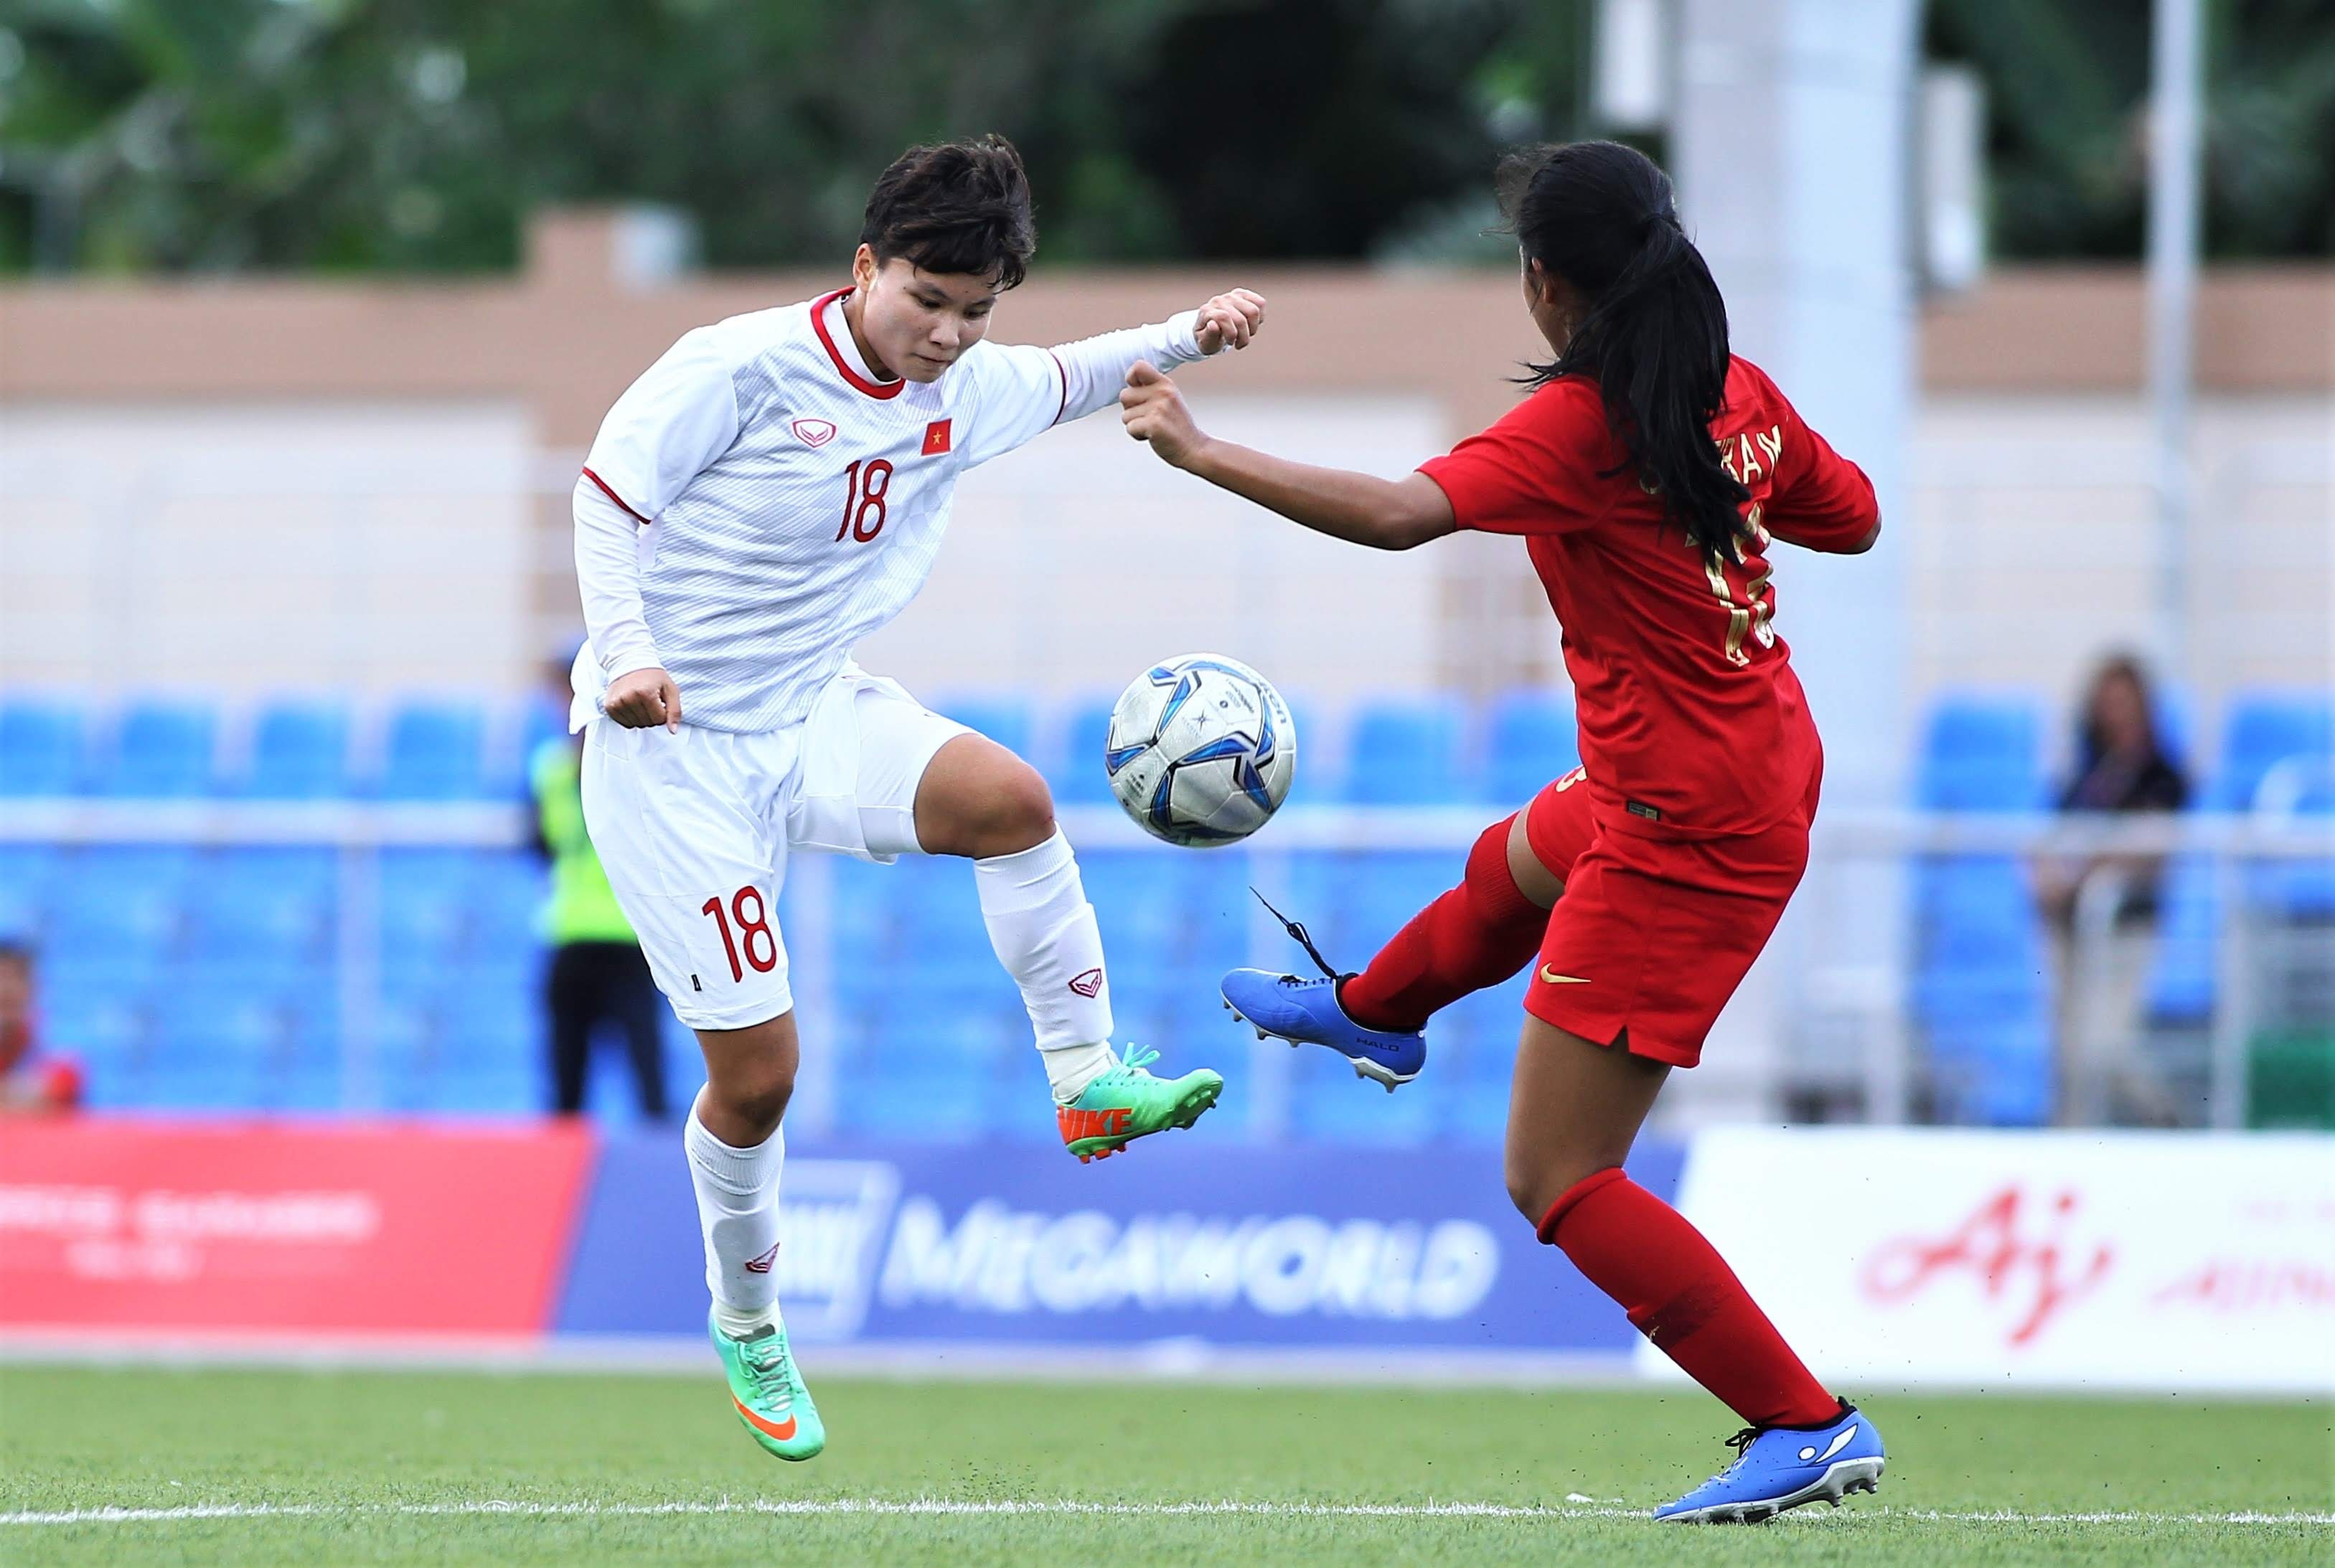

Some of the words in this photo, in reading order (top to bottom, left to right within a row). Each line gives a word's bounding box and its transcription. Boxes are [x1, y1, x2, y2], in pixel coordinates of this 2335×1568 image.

[835, 458, 894, 543] 18
[701, 884, 778, 984] 18
[1356, 1037, 1400, 1052] HALO
[1057, 1105, 1132, 1146] NIKE
